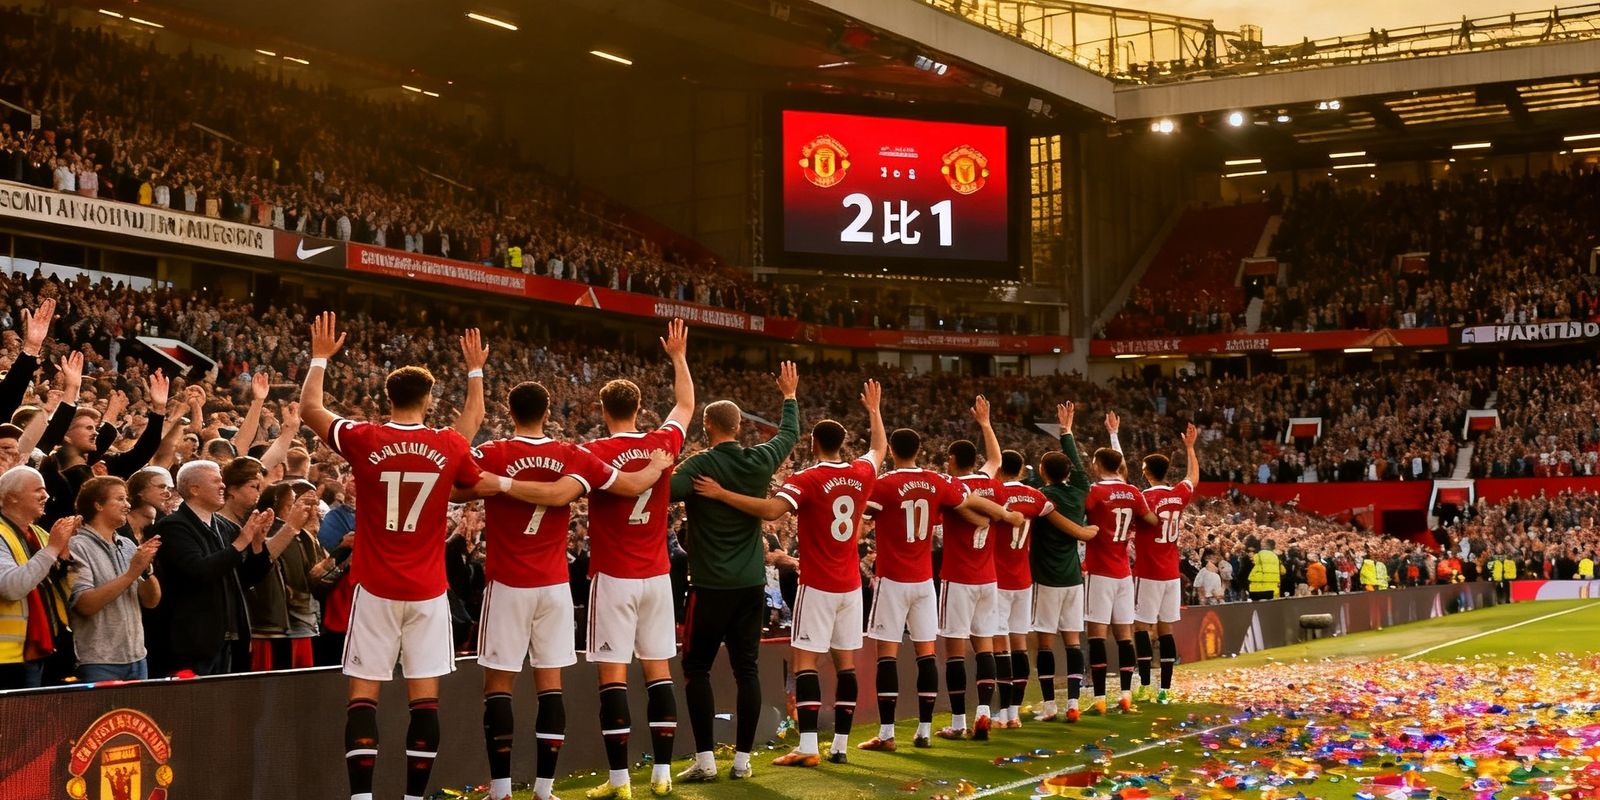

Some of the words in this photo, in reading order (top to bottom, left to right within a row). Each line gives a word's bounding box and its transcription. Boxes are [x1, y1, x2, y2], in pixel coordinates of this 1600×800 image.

[840, 193, 952, 247] 2比1
[379, 471, 440, 532] 17
[831, 495, 855, 542] 8
